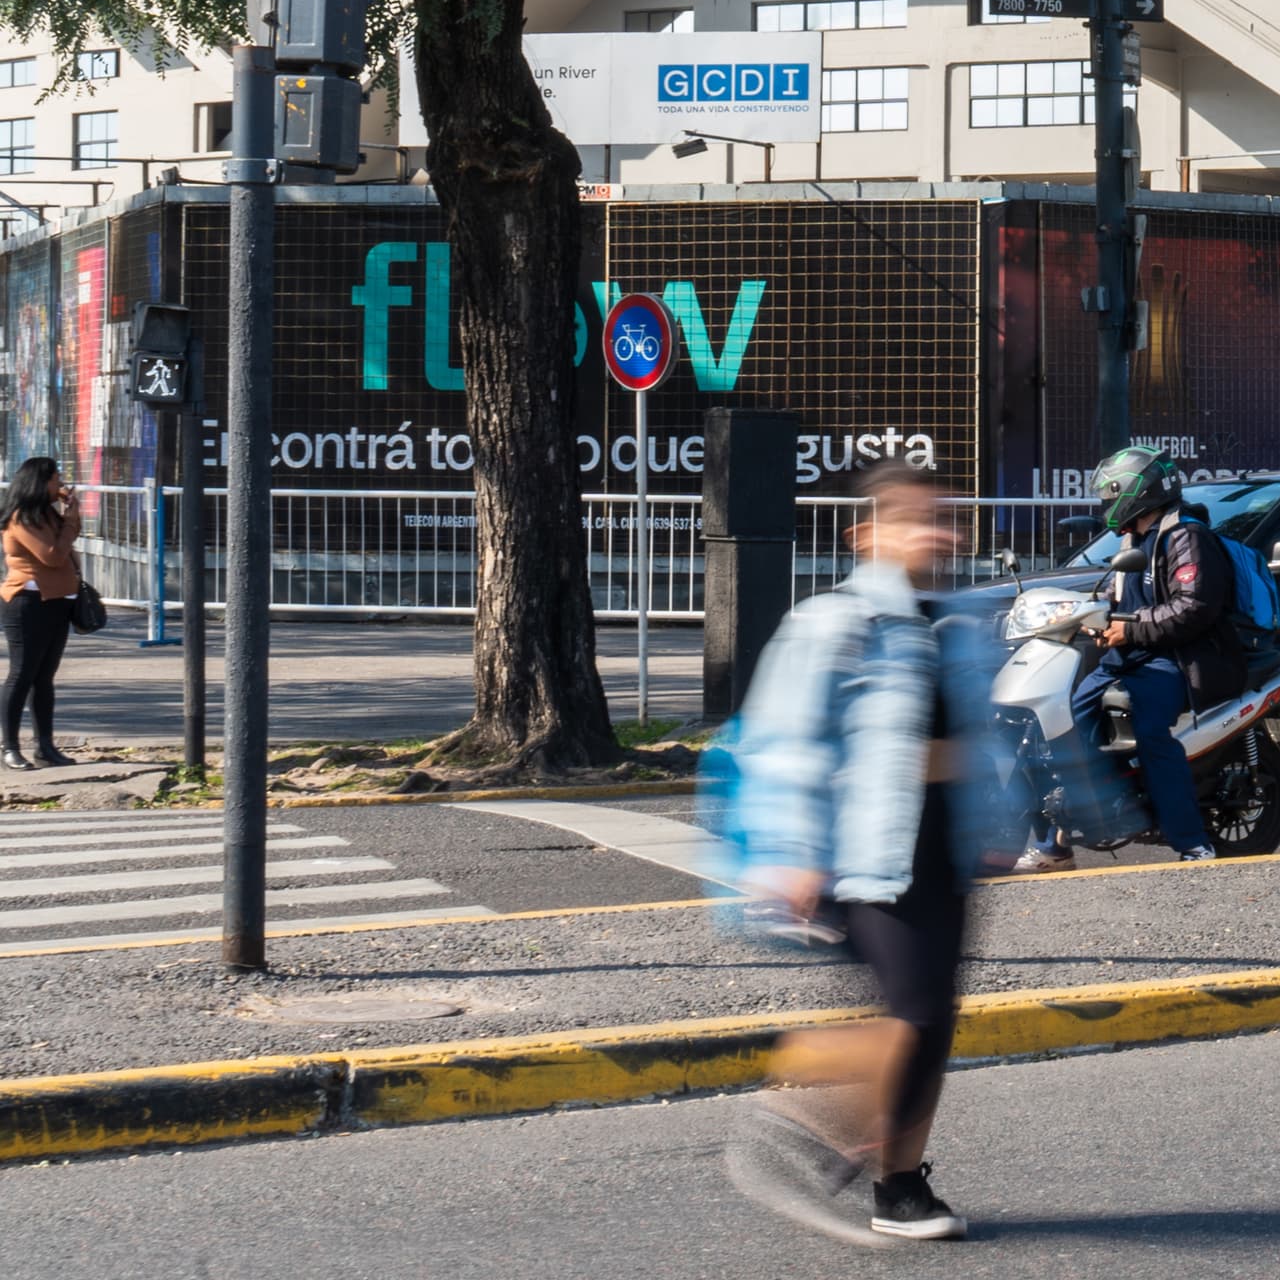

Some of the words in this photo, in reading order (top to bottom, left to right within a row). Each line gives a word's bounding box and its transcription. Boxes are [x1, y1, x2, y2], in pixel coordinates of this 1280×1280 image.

[1034, 0, 1062, 13] 7750
[558, 66, 597, 79] River
[661, 66, 804, 99] GCDI
[658, 105, 683, 114] TODA
[685, 105, 705, 114] UNA
[708, 105, 730, 113] VIDA
[732, 104, 810, 113] CONSTRUYENDO
[351, 241, 767, 391] flw
